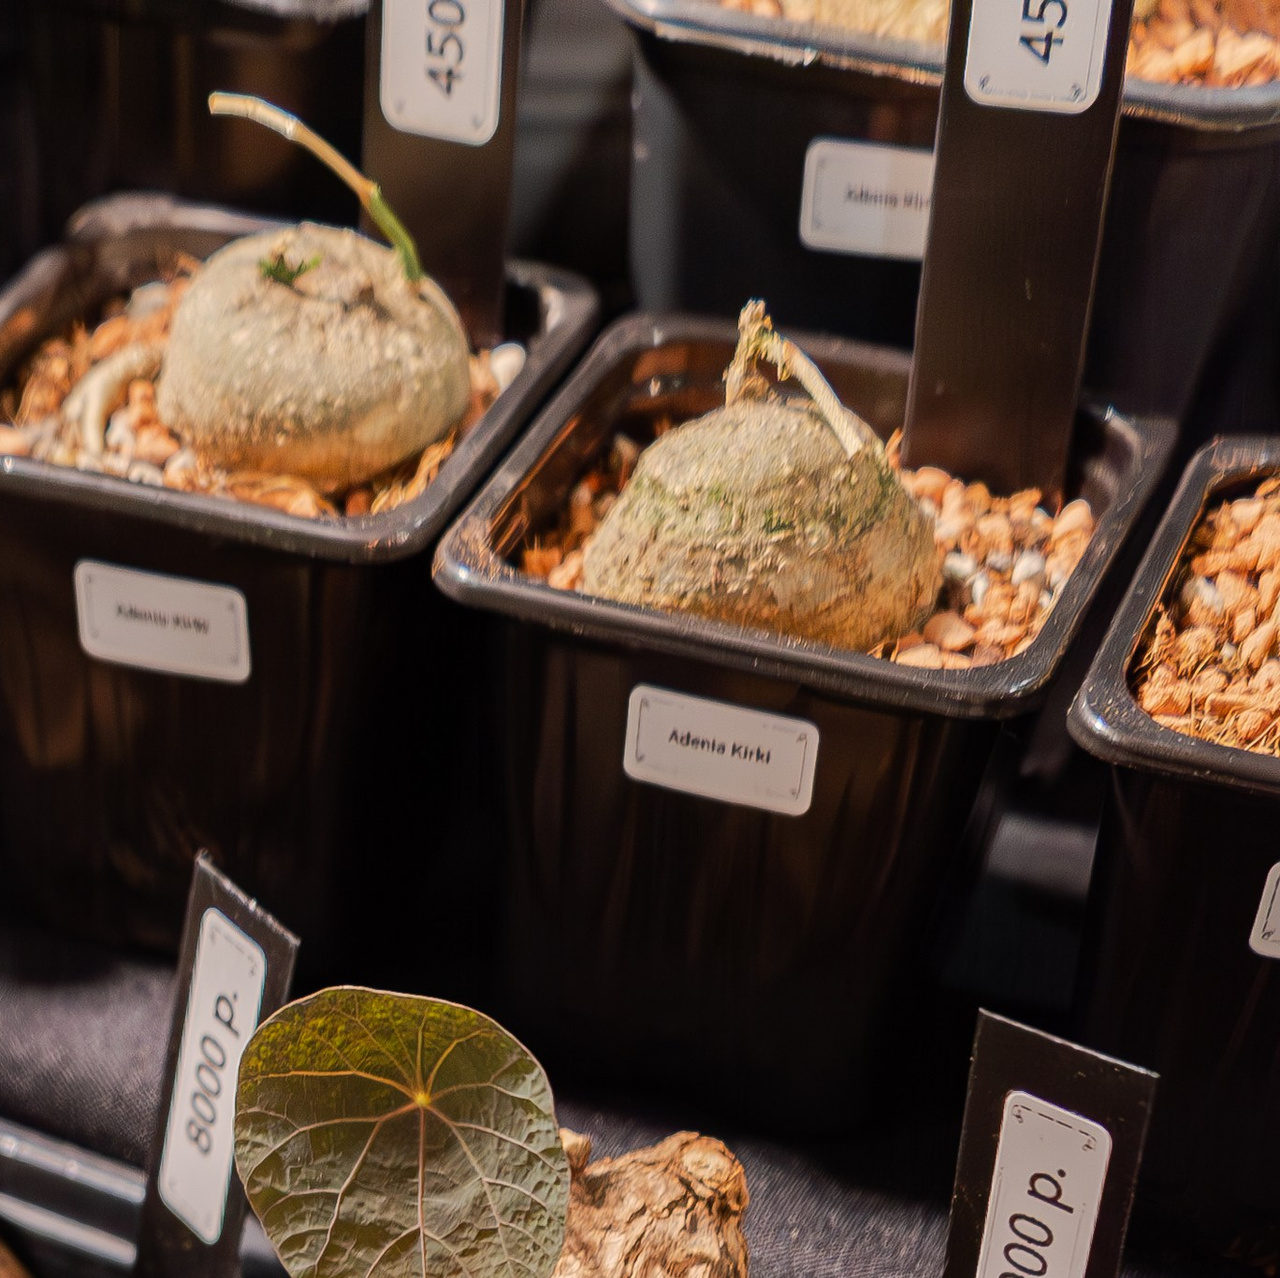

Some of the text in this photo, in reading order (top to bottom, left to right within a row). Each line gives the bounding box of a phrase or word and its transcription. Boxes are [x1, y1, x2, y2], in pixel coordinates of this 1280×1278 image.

[669, 727, 771, 765] Adenia Kirki
[186, 1034, 227, 1155] 8000
